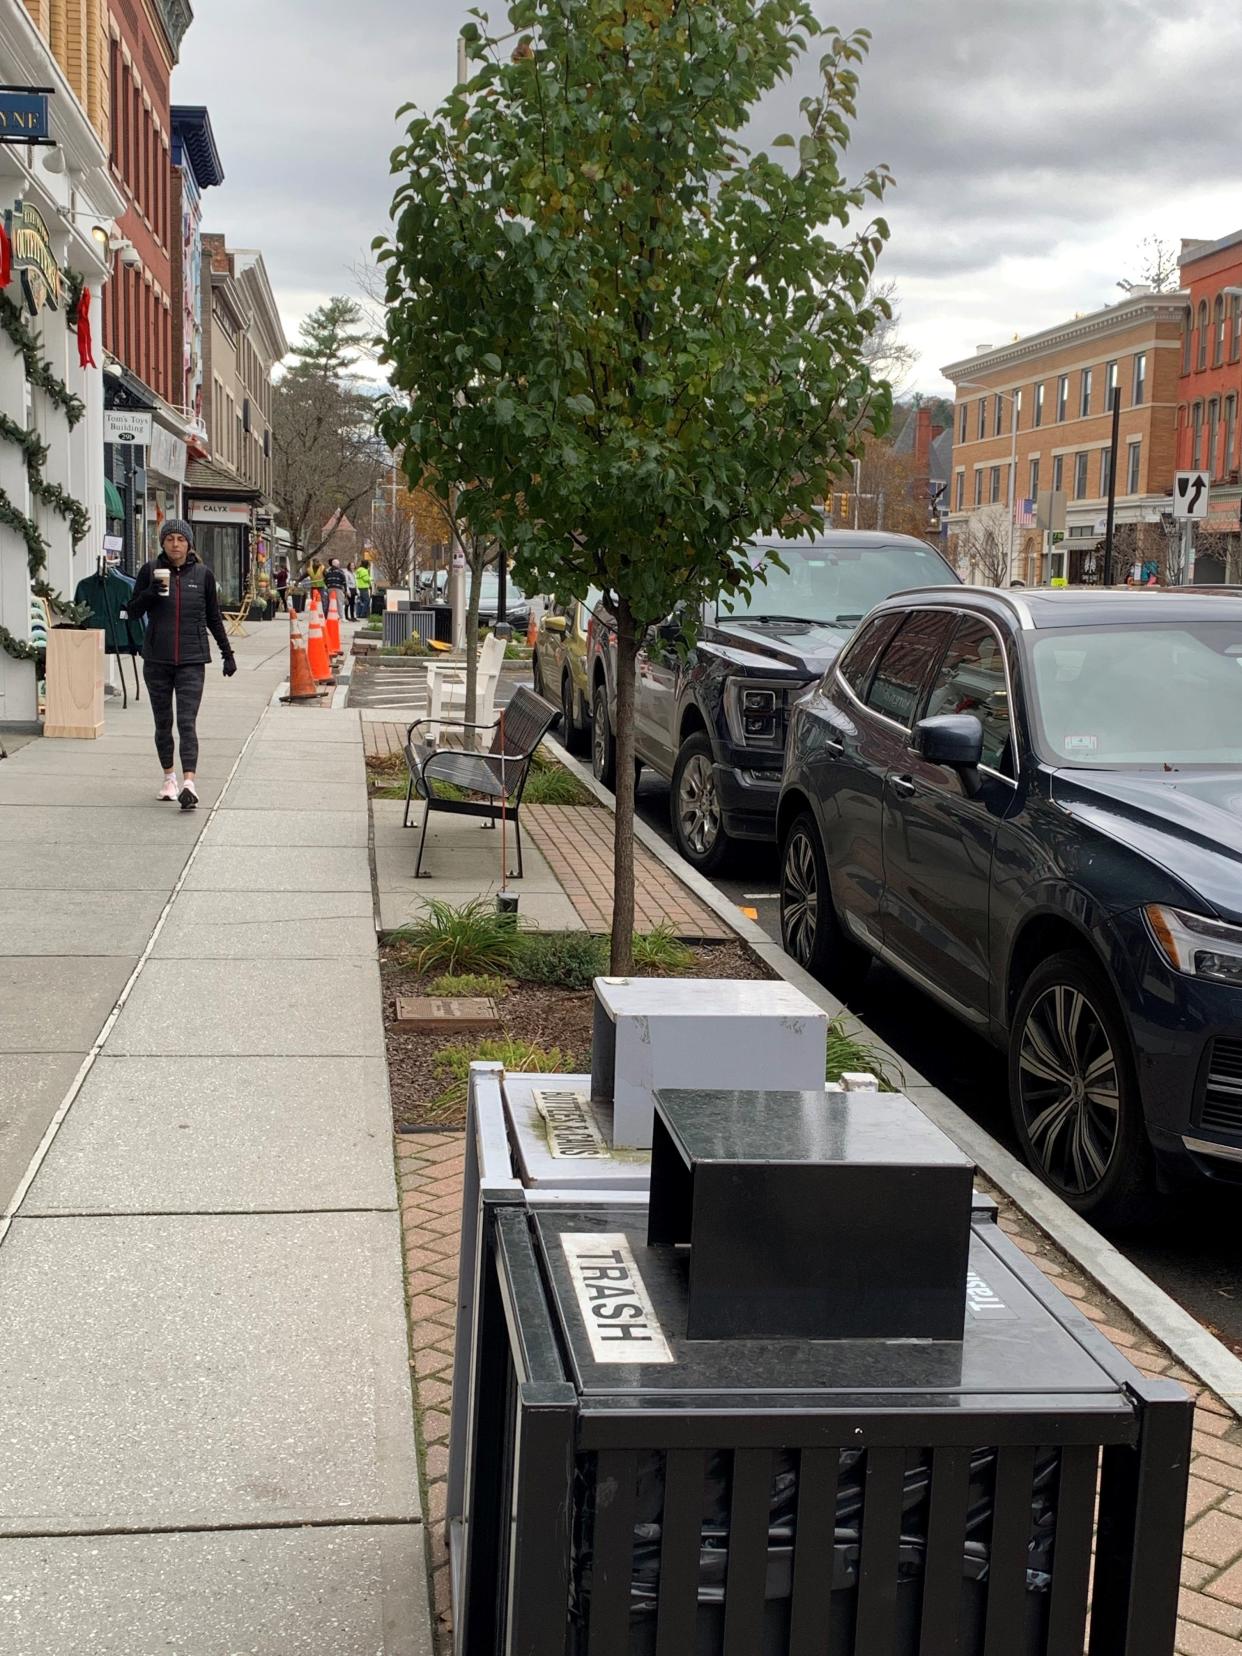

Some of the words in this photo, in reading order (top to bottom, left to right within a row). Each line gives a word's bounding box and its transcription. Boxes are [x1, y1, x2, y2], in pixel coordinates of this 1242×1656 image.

[106, 414, 128, 422] Tom's
[131, 416, 148, 425] Toys
[110, 423, 144, 433] Building
[203, 504, 228, 512] CALYX
[540, 1091, 587, 1123] BOTTLES
[554, 1133, 601, 1156] CANS
[576, 1249, 653, 1342] TRASH
